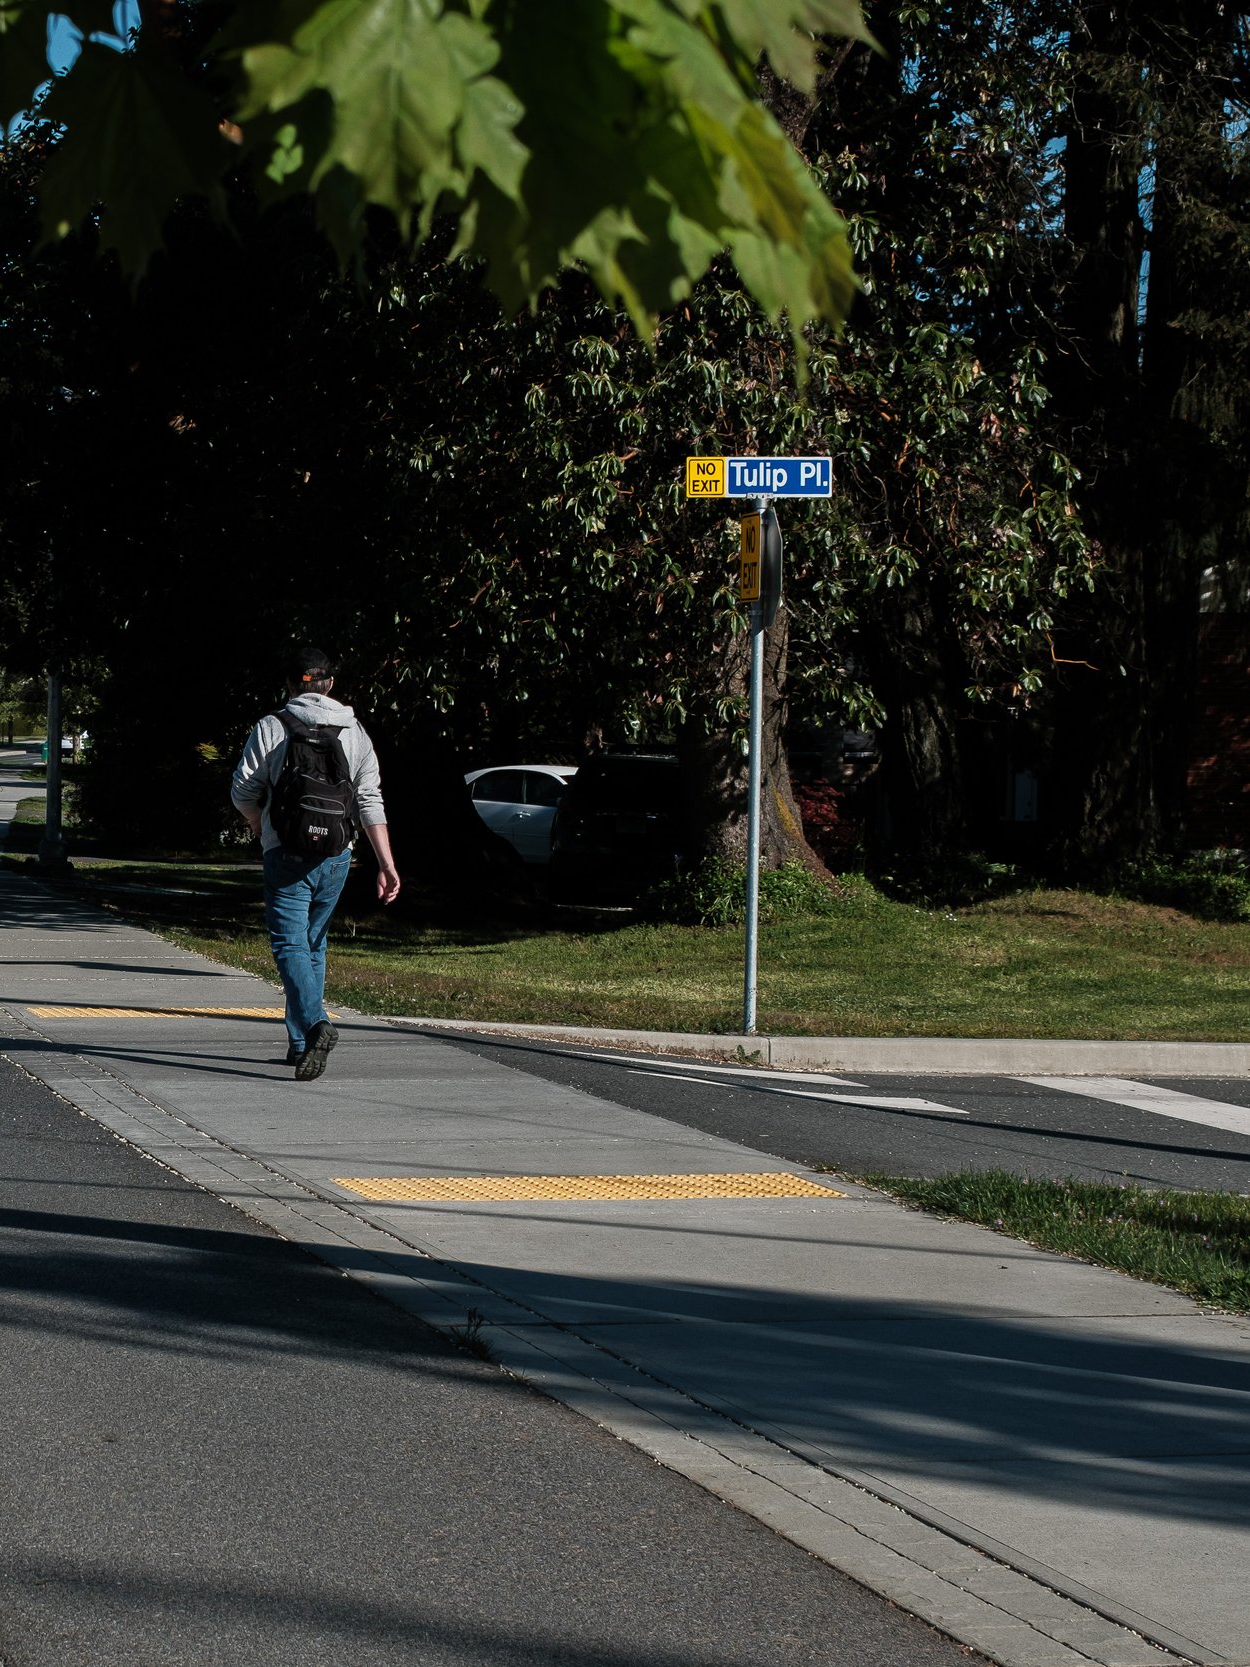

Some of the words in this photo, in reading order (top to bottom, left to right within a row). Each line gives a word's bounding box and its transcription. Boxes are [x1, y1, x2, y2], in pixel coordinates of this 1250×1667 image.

[696, 462, 716, 476] NO
[730, 462, 788, 492] Tulip
[800, 462, 828, 487] Pl.
[692, 479, 720, 492] EXIT
[745, 526, 756, 554] NO
[743, 562, 757, 590] EXIT
[308, 825, 329, 836] ROOTS
